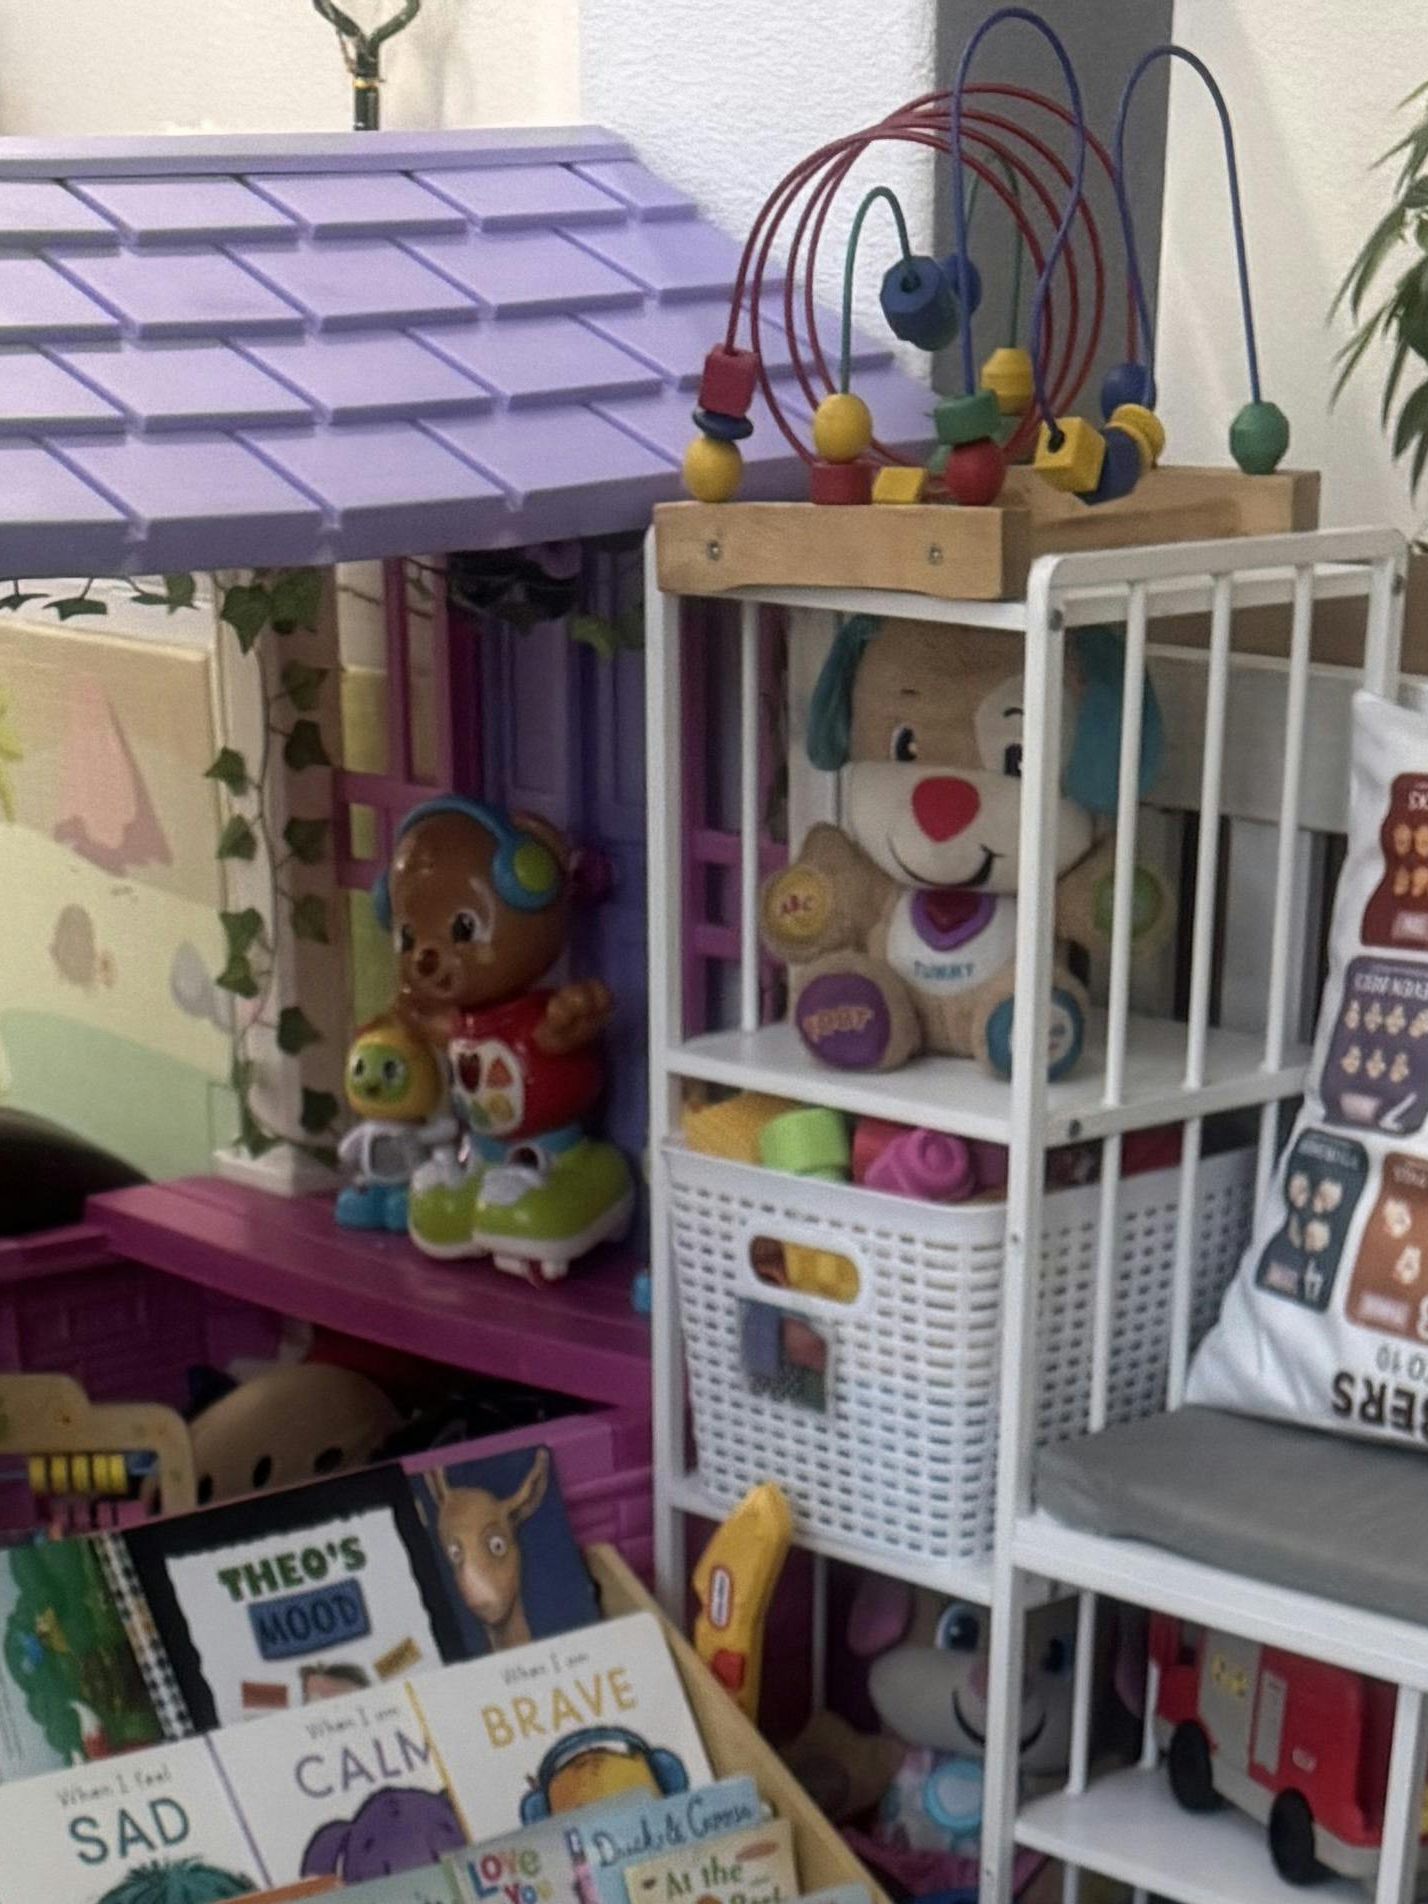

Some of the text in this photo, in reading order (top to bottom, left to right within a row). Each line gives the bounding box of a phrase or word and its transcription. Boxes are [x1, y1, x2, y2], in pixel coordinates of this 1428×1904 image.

[1378, 1091, 1418, 1132] 7
[1375, 1343, 1403, 1373] 10
[217, 1536, 368, 1602] THEO'S
[259, 1594, 361, 1648] MOOD
[304, 1714, 354, 1741] When
[358, 1706, 371, 1726] I
[480, 1666, 638, 1749] BRAVE
[56, 1763, 173, 1806] When I feel
[67, 1797, 191, 1866] SAD
[664, 1856, 743, 1899] At the
